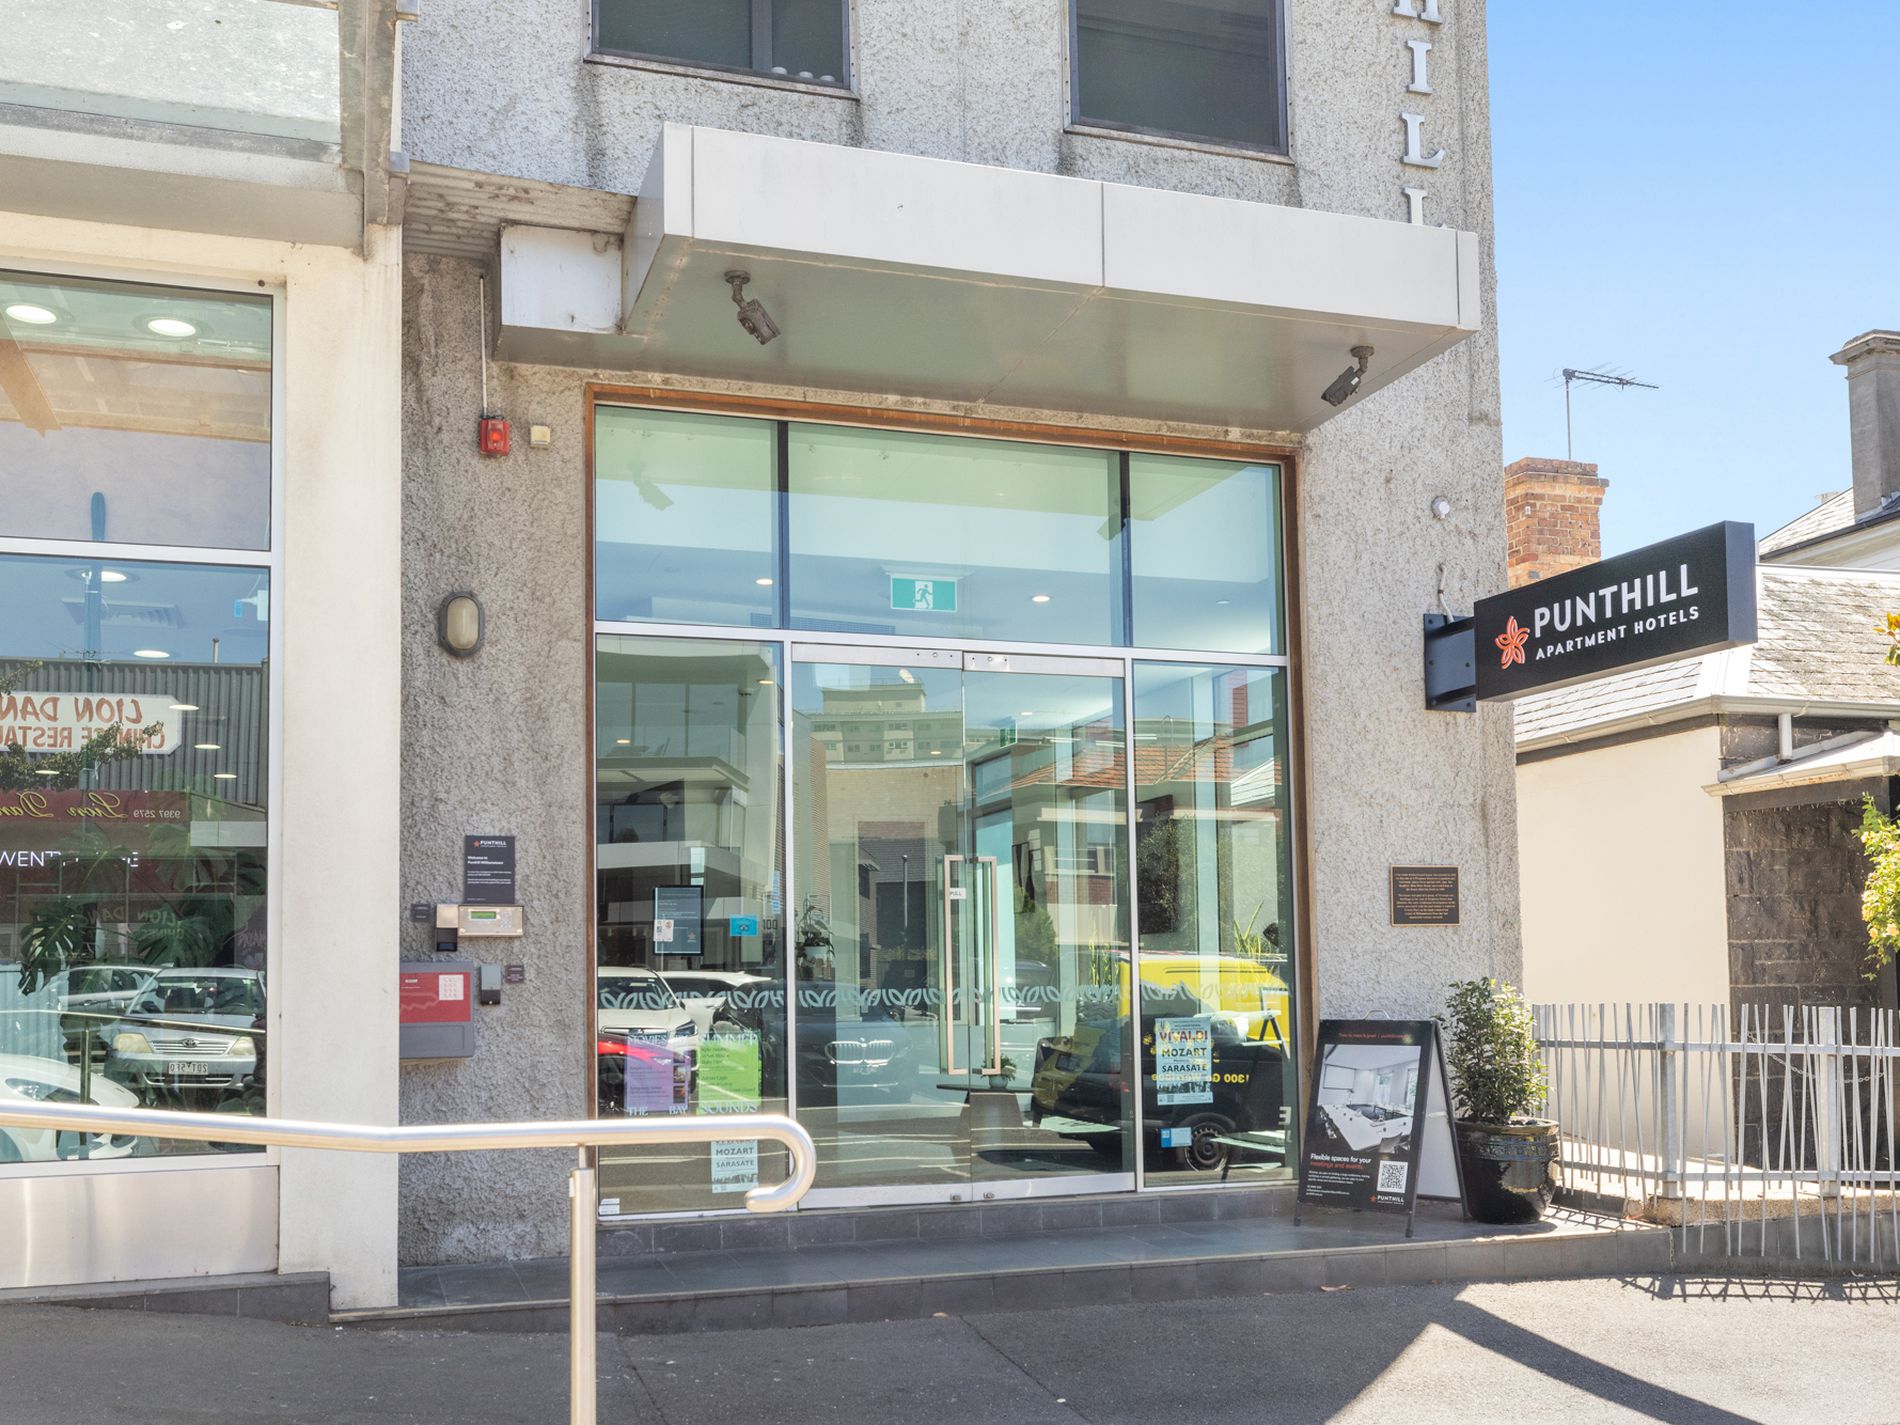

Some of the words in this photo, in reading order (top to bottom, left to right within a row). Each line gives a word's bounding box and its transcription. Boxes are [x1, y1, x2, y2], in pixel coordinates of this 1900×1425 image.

[1534, 563, 1699, 639] PUNTHILL
[1535, 625, 1628, 661] APARTMENT
[1633, 605, 1700, 634] HOTELS
[1159, 1030, 1208, 1041] VIVALDI
[1162, 1048, 1207, 1057] MOZART
[1161, 1064, 1208, 1072] SARASATE
[628, 1105, 648, 1117] THE
[701, 1102, 758, 1113] SOUNDS
[716, 1148, 754, 1156] MOZART
[1310, 1153, 1330, 1161] Flexible
[716, 1160, 754, 1168] SARASATE
